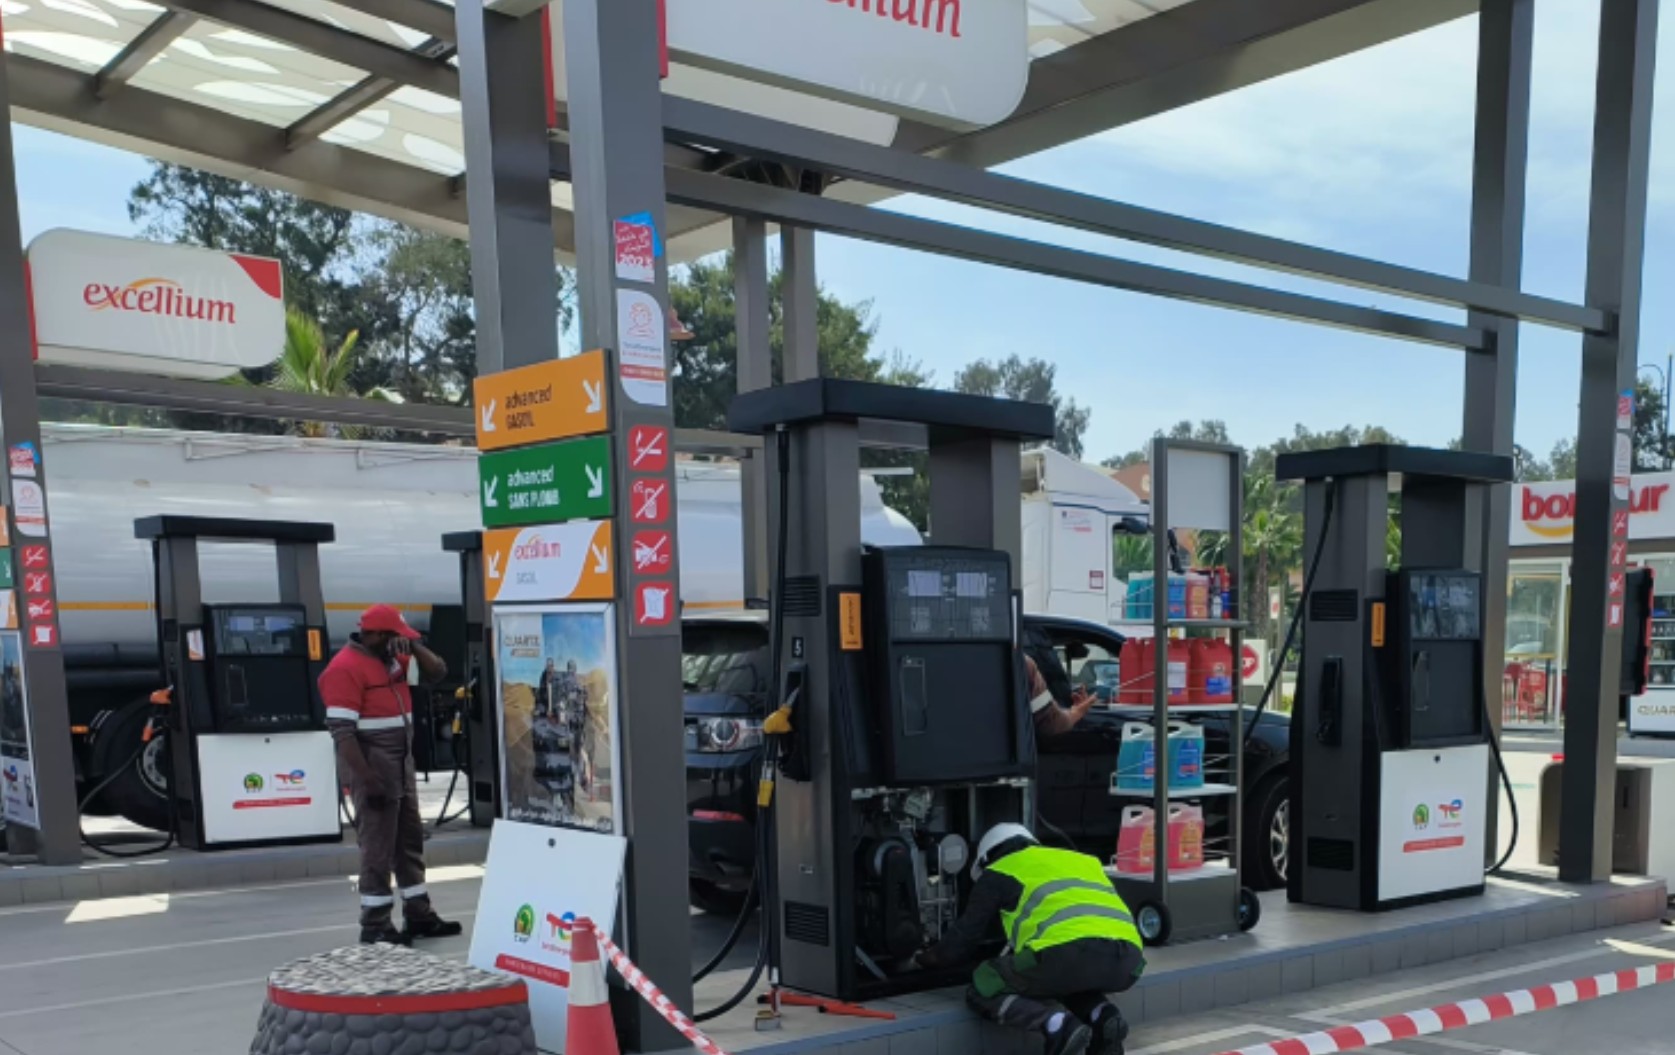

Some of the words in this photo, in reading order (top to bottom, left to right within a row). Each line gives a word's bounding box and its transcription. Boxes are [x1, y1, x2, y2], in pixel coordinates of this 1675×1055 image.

[83, 281, 235, 323] excellium
[506, 384, 551, 409] advanced
[507, 465, 554, 487] advanced
